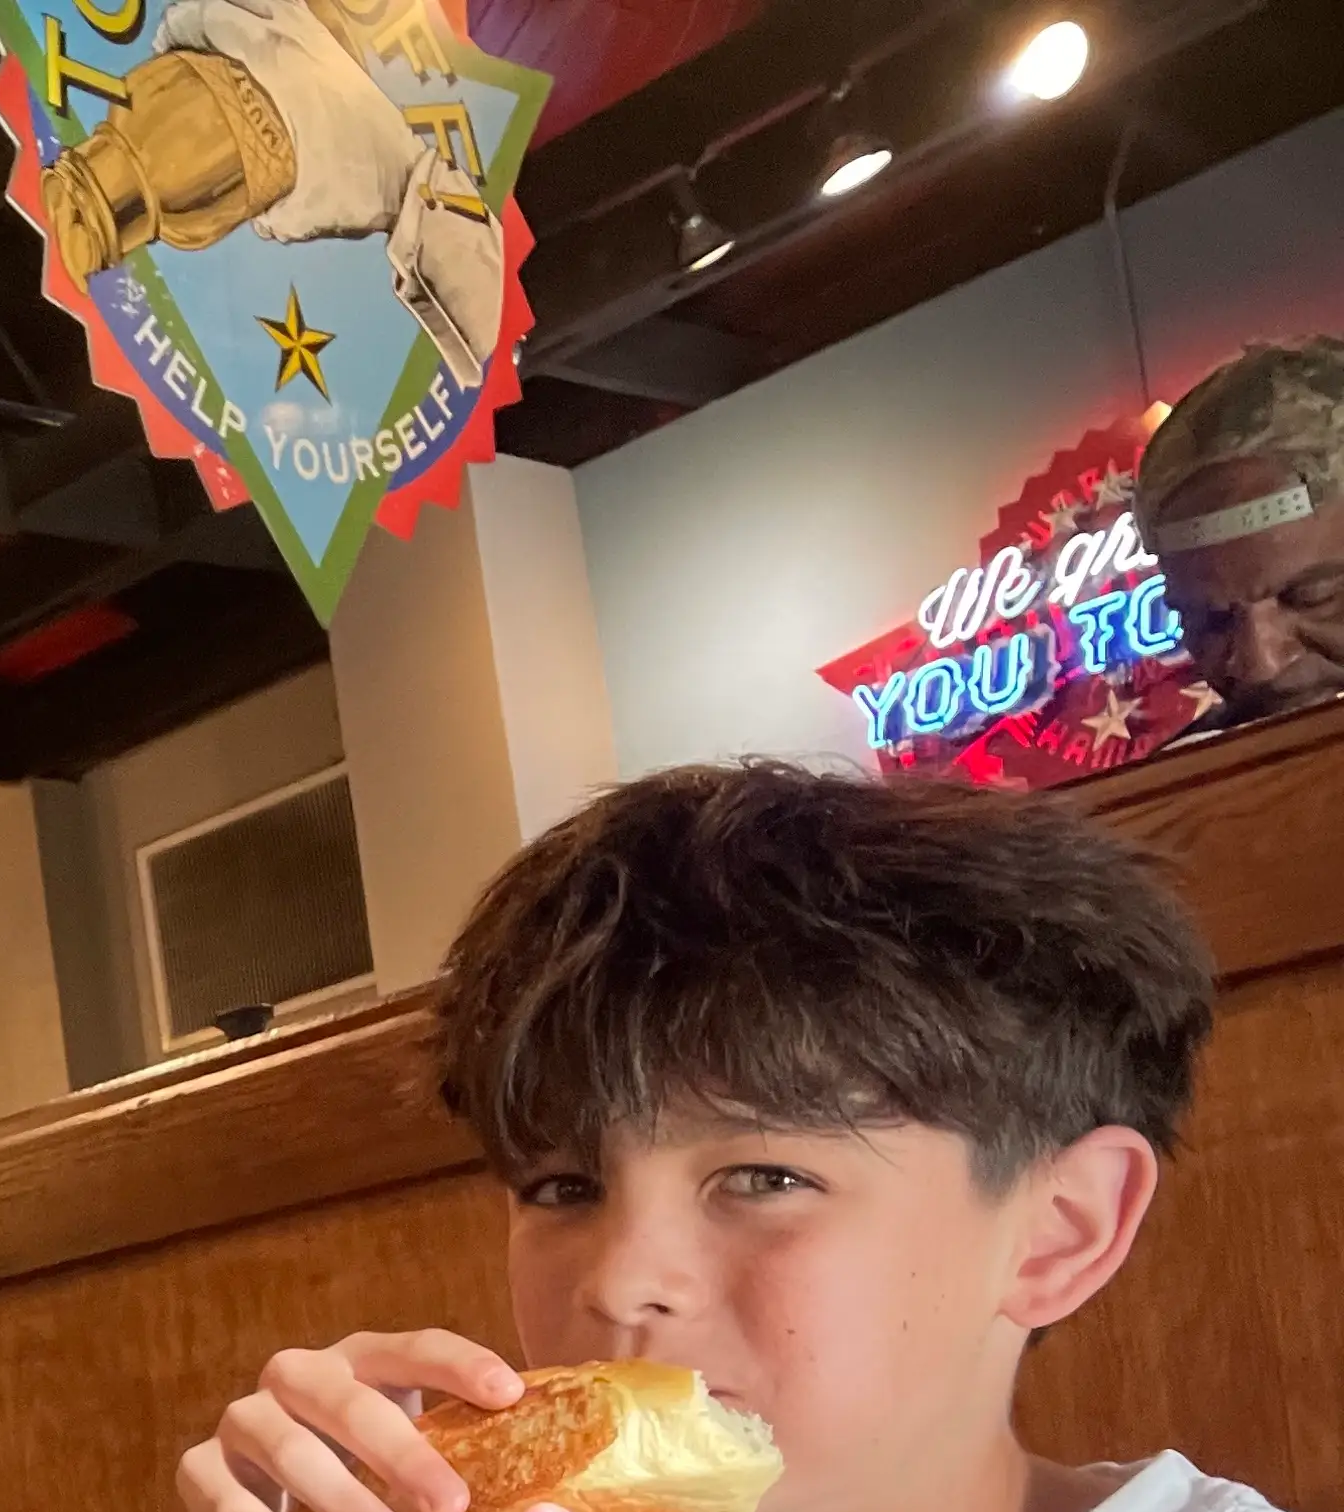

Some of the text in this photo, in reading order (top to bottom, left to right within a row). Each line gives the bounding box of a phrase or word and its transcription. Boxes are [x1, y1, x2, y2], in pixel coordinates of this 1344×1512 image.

[133, 314, 454, 484] HELP YOURSELF
[917, 545, 1044, 648] We
[852, 633, 1032, 749] YOU
